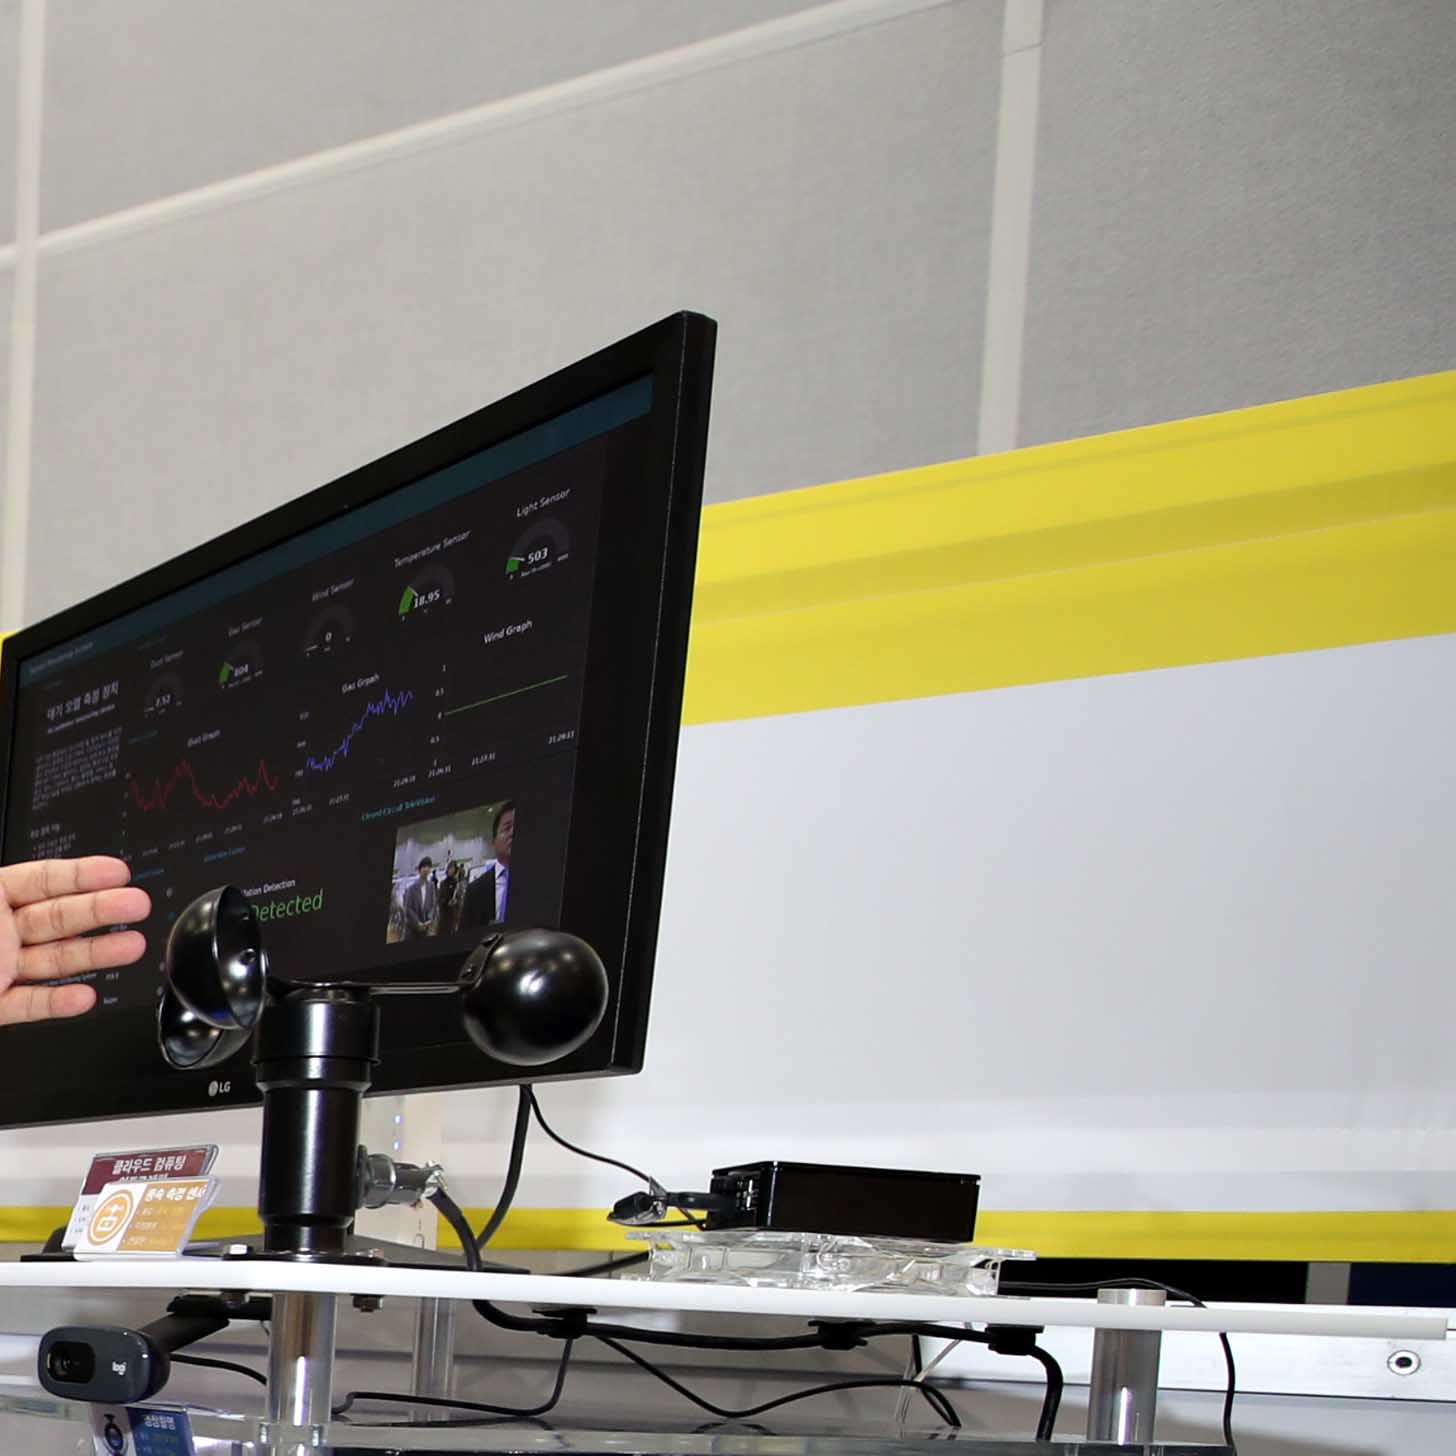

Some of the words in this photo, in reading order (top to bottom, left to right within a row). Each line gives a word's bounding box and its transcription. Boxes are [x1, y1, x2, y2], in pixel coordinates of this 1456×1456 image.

[527, 548, 549, 565] 503
[112, 1158, 153, 1176] 클라우드
[153, 1155, 187, 1172] 컴퓨팅
